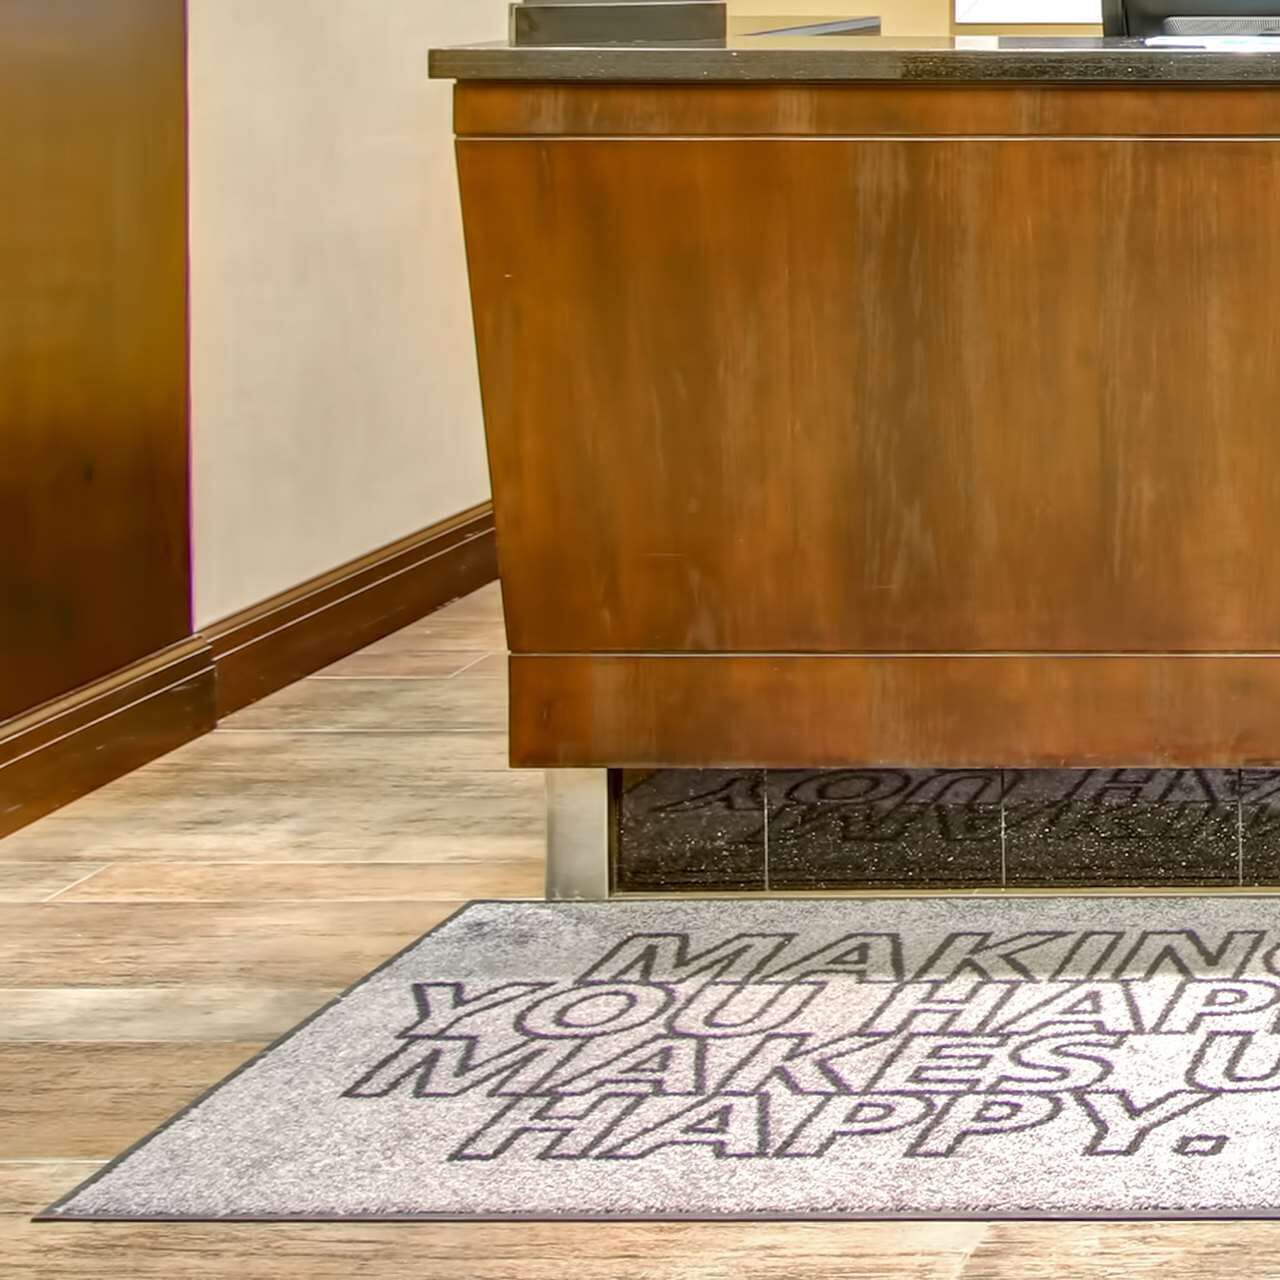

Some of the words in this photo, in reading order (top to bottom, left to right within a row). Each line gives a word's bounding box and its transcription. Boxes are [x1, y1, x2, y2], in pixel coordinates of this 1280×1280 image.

[396, 980, 828, 1039] YOU
[341, 1030, 1128, 1098] MAKES
[447, 1089, 1230, 1161] HAPPY.
